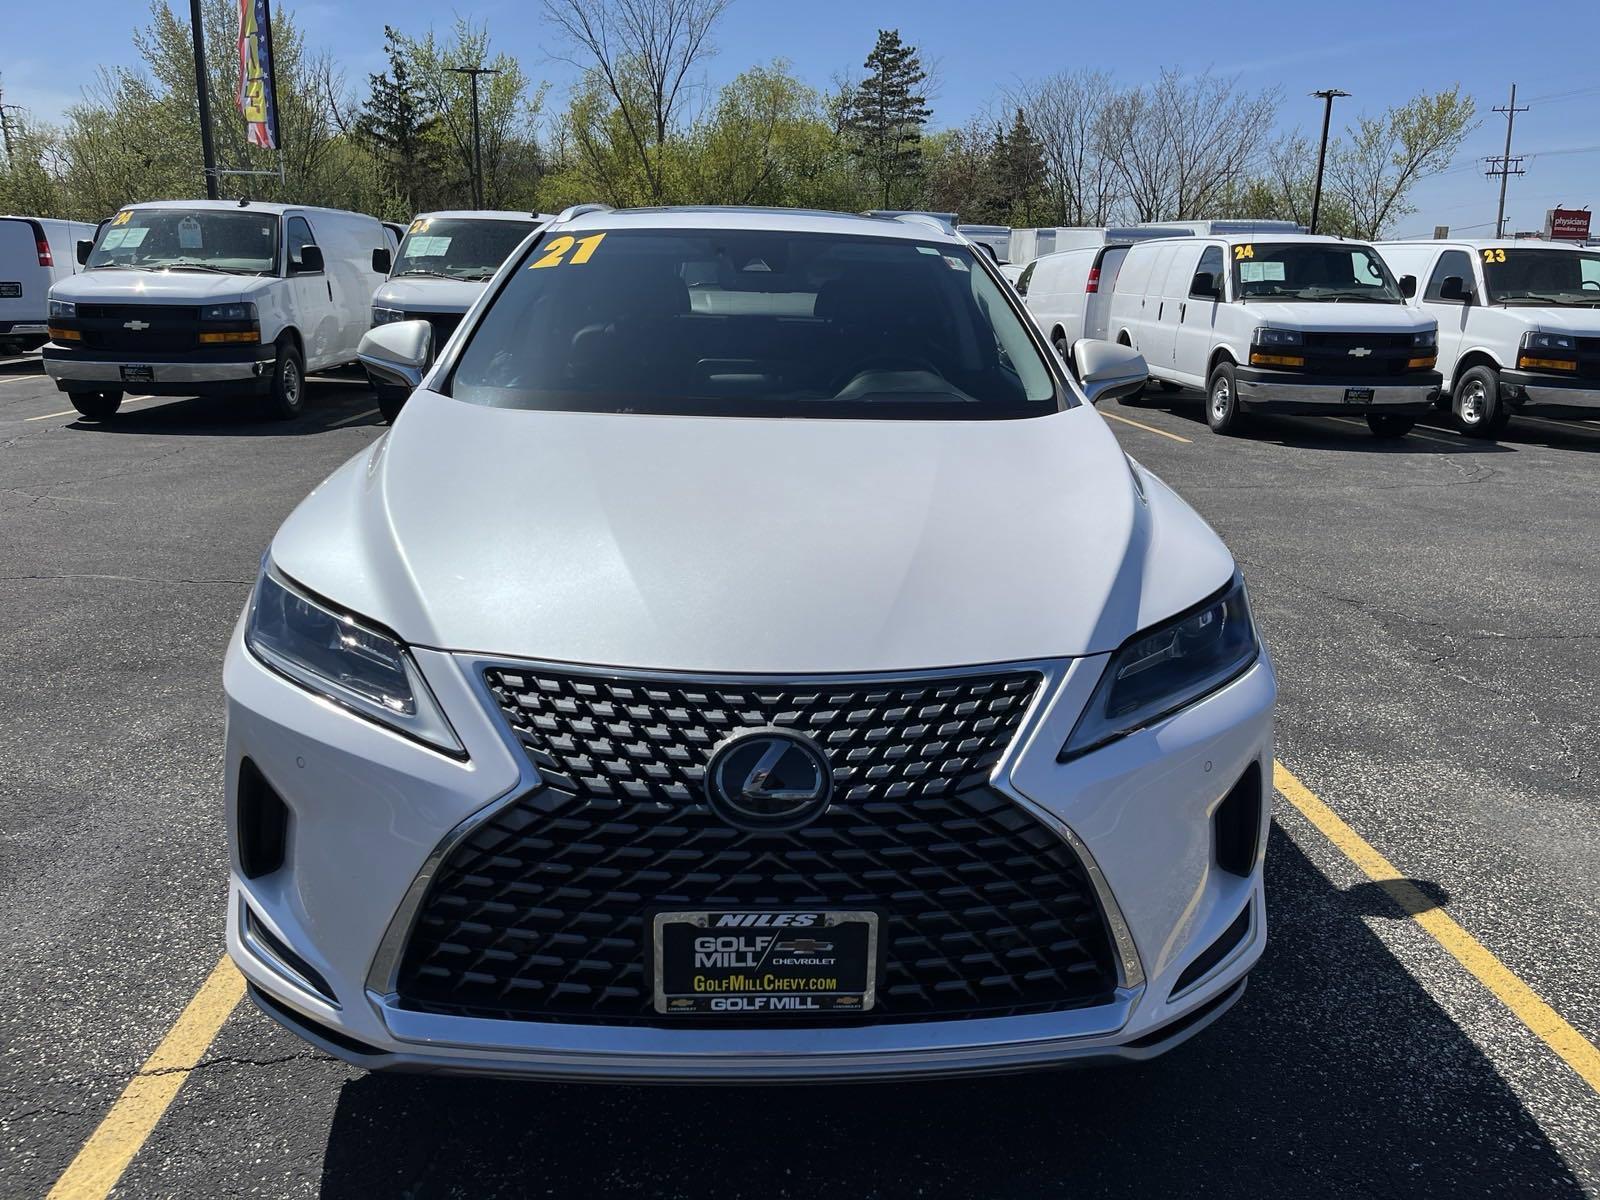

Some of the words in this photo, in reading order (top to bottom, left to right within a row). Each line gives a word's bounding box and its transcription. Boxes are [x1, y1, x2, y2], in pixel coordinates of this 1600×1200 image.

[112, 211, 134, 226] 24
[1554, 217, 1588, 227] physicians
[528, 232, 607, 270] 21
[1235, 244, 1254, 260] 24
[1484, 249, 1506, 263] 23
[715, 914, 818, 927] NILES
[694, 936, 773, 952] GOLF
[695, 952, 758, 968] MILL
[711, 998, 767, 1011] GOLF
[770, 997, 820, 1010] MILL
